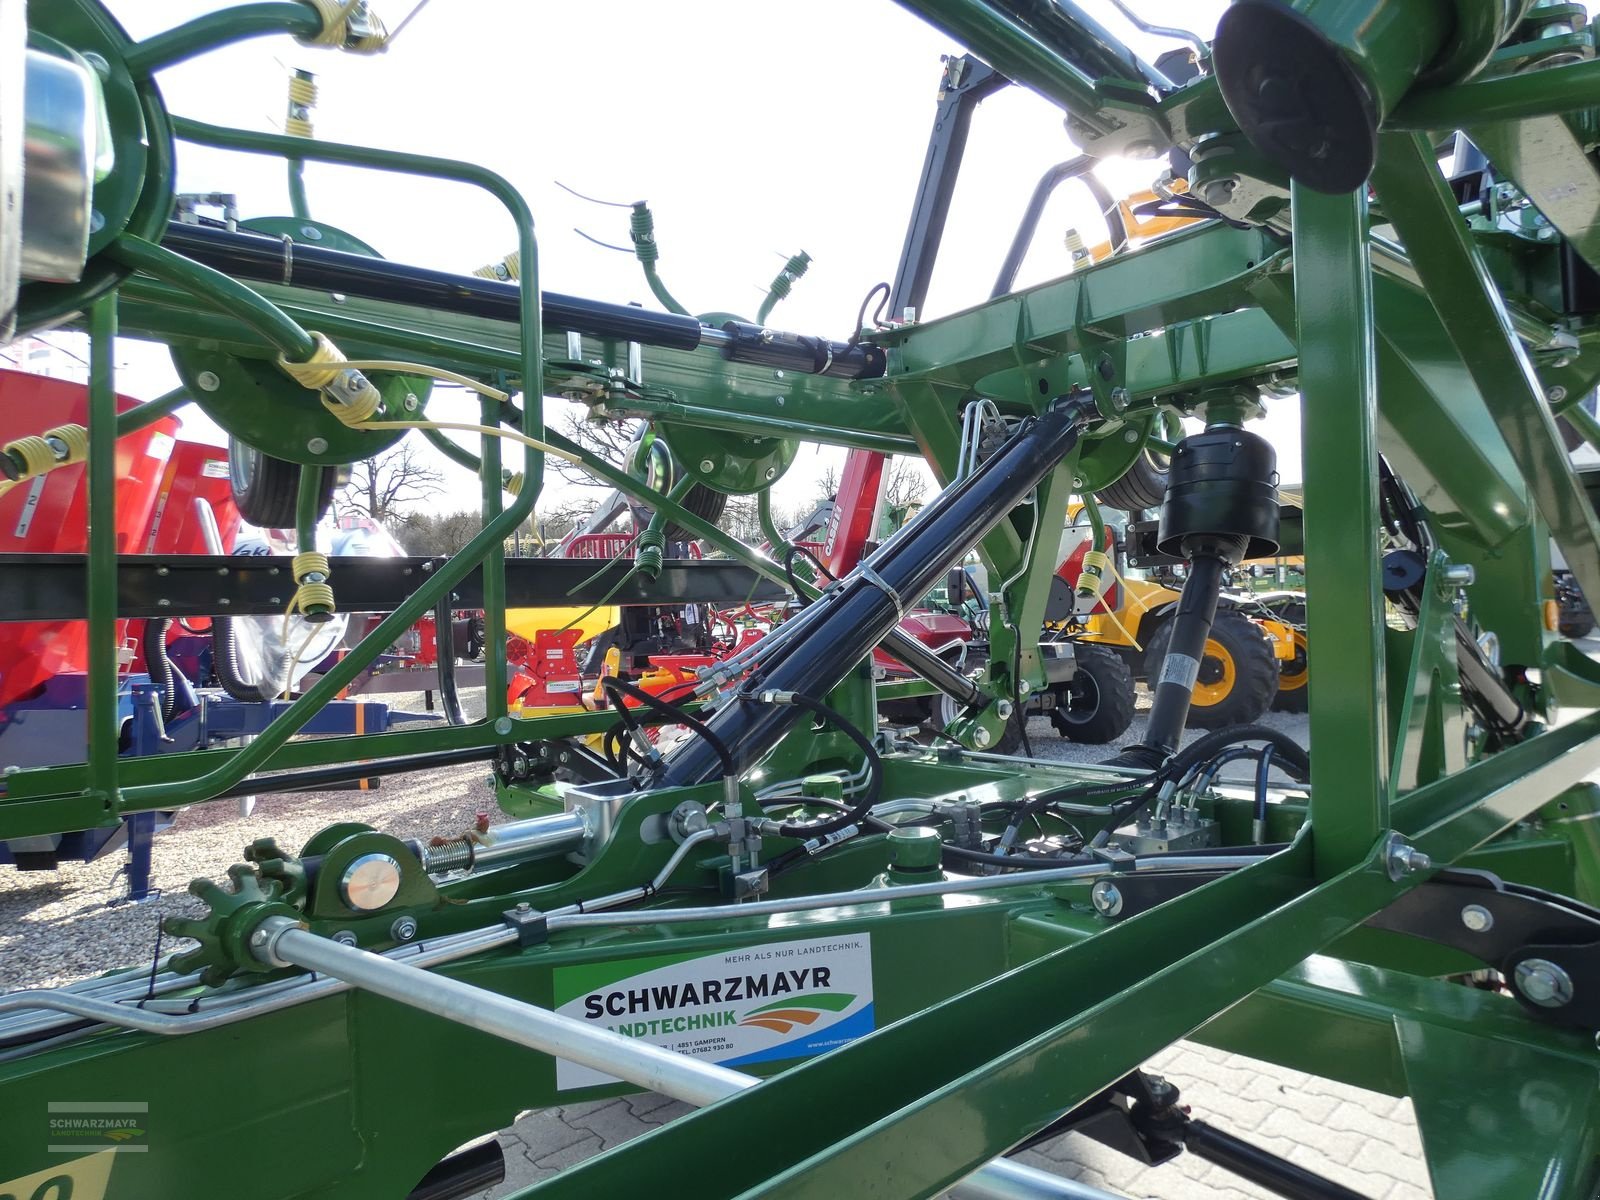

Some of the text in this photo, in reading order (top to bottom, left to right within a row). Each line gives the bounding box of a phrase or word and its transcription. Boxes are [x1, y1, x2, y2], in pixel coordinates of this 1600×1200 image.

[725, 941, 863, 964] MEHR ALS NUR LANDTECHNIK.
[584, 966, 831, 1019] SCHWARZMAYR
[677, 1041, 693, 1049] 4851
[694, 1037, 726, 1047] GAMPERN
[692, 1045, 712, 1055] 07682
[712, 1044, 725, 1052] 930
